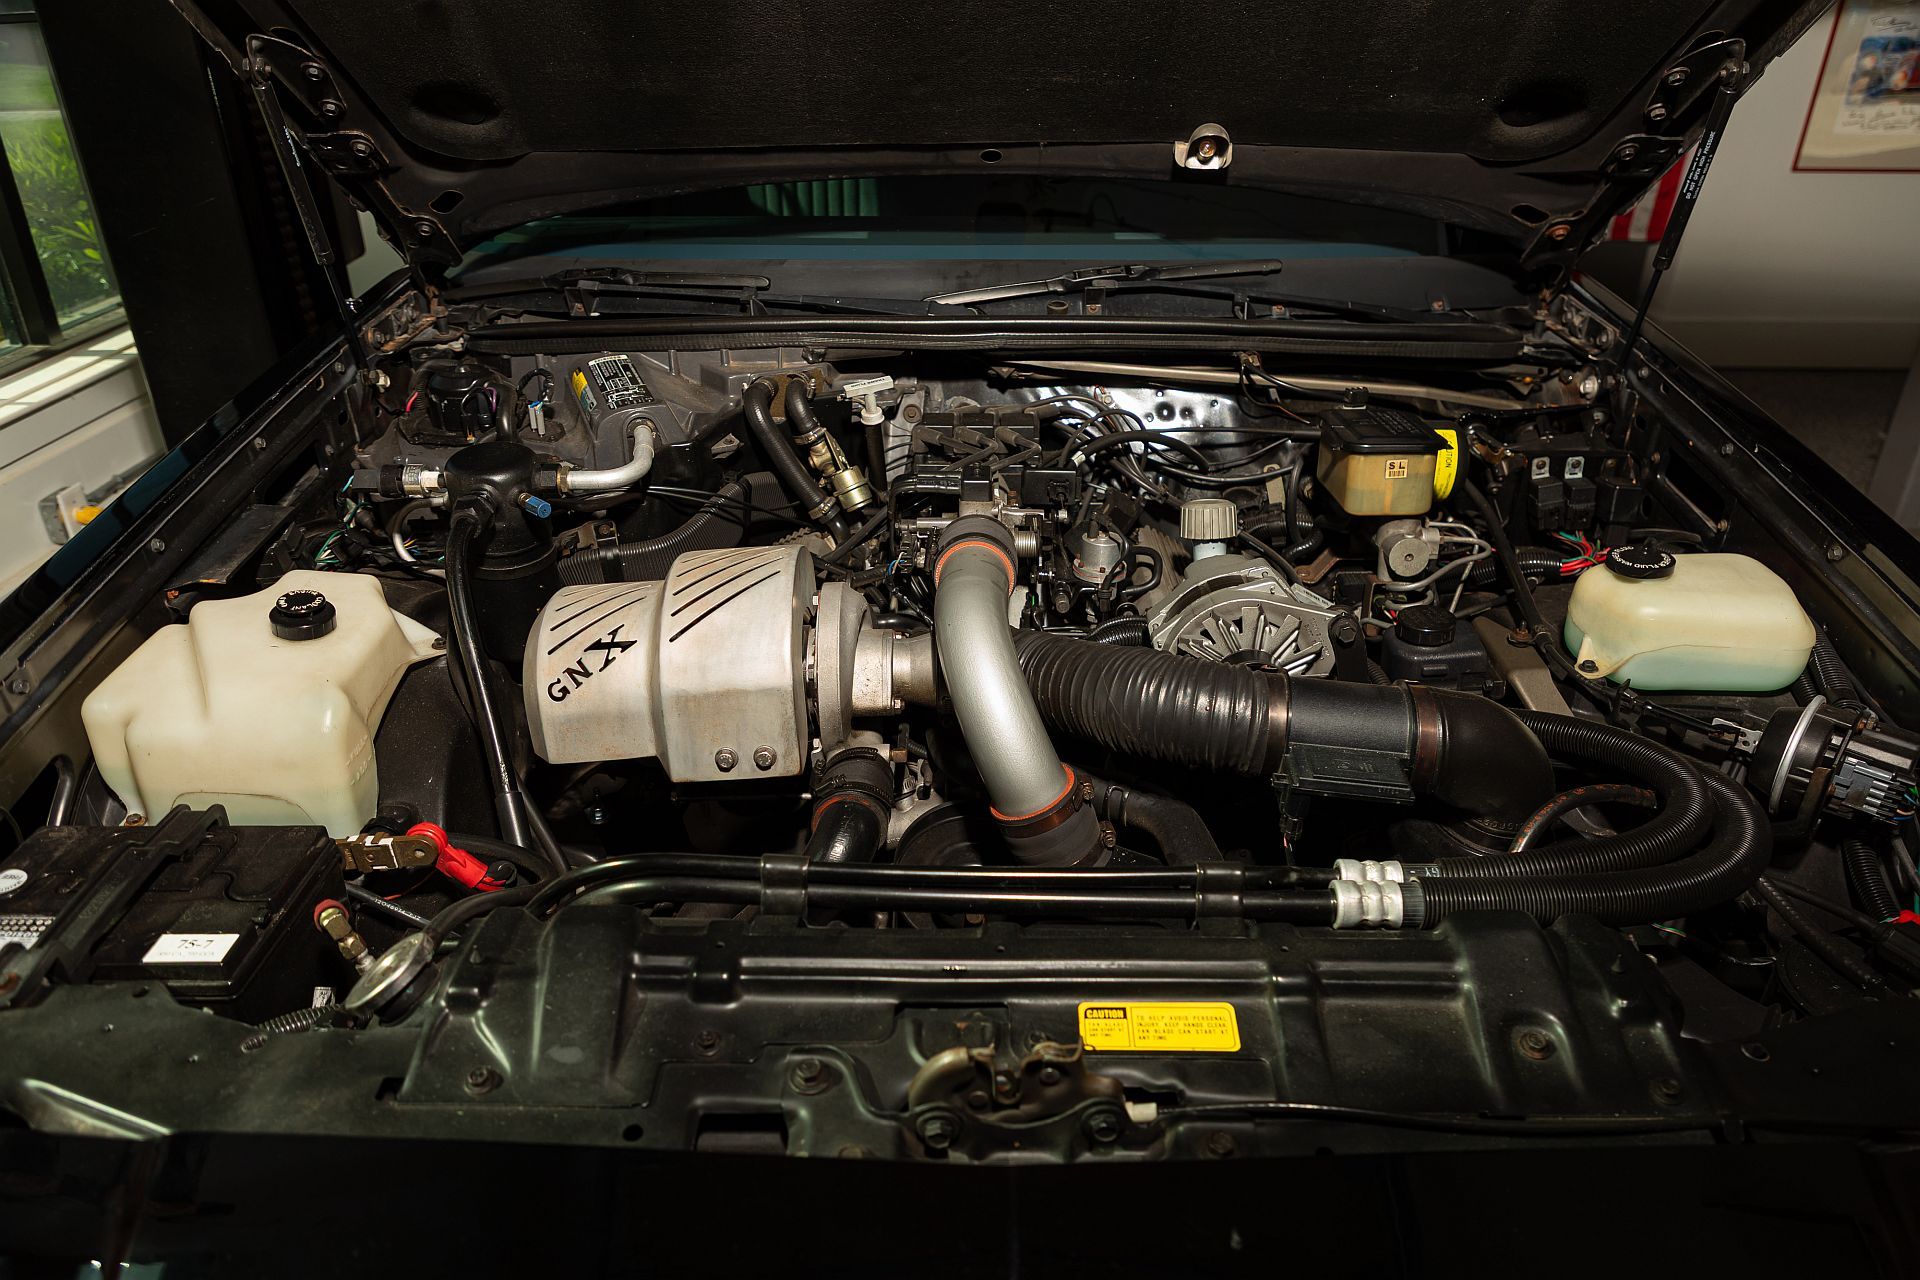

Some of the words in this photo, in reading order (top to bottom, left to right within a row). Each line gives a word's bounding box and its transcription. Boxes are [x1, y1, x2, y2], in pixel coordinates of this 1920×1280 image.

[1693, 168, 1701, 180] OPEN
[1703, 131, 1716, 154] PRESSURE
[290, 596, 324, 610] COOLANT
[547, 623, 638, 702] GNX
[1086, 1010, 1124, 1019] CAUTION
